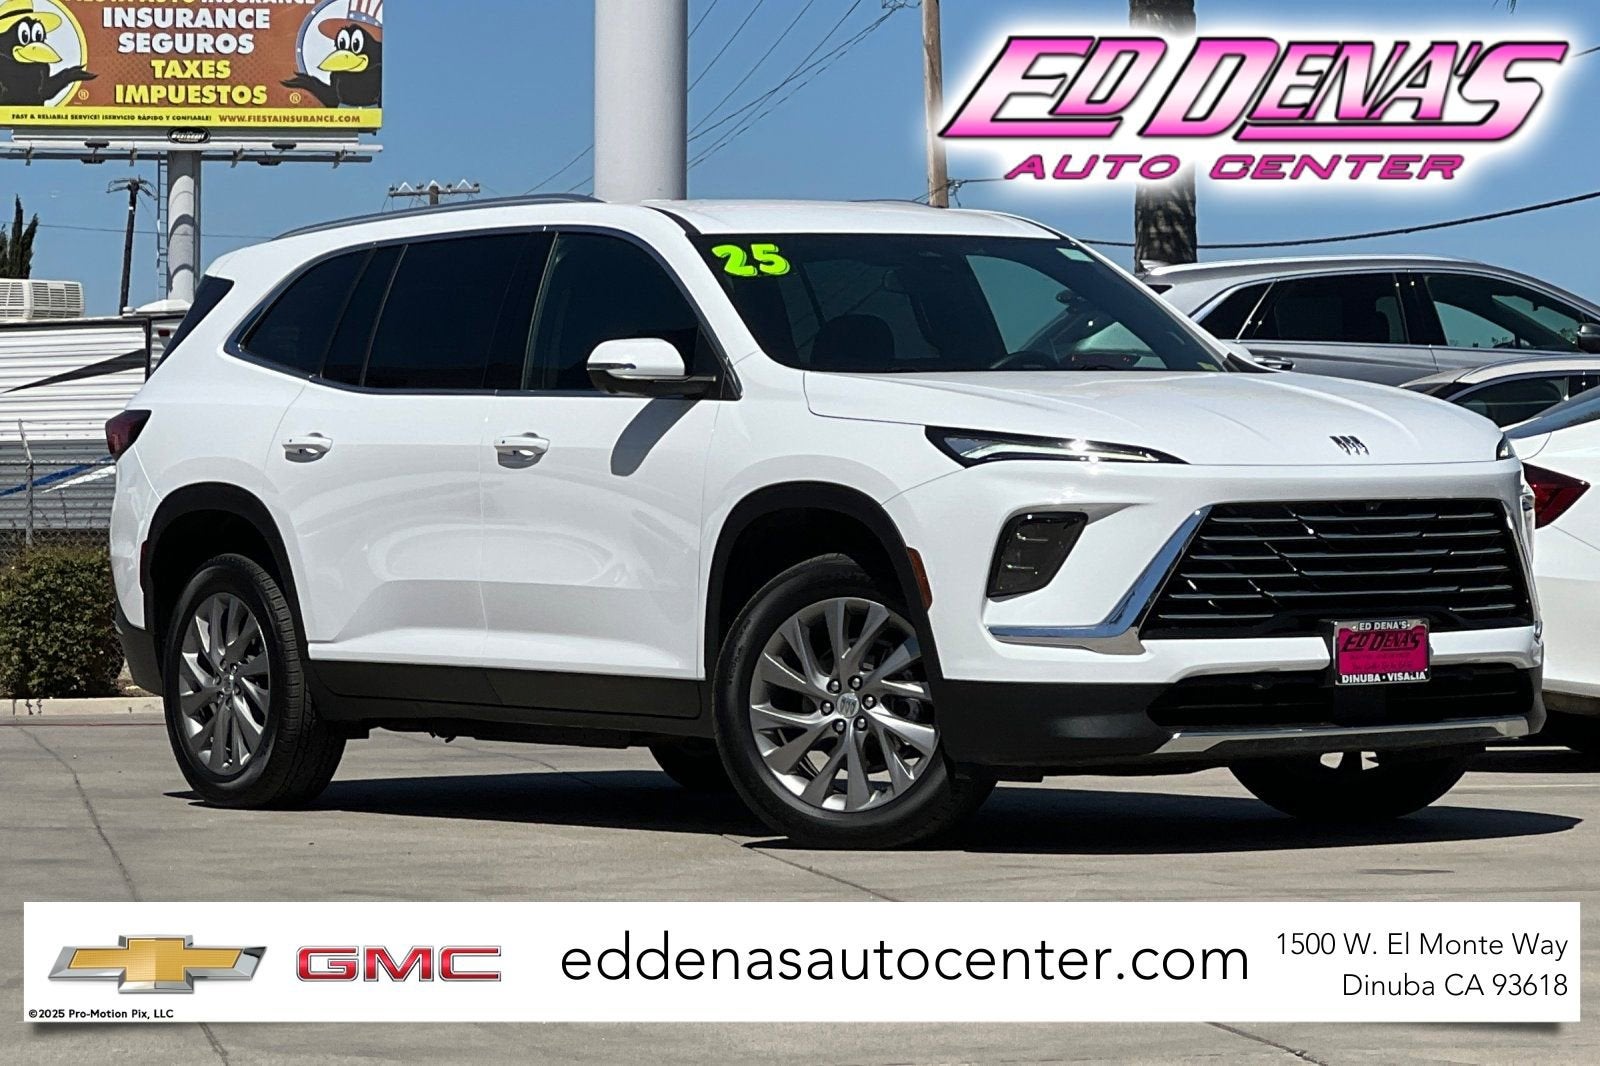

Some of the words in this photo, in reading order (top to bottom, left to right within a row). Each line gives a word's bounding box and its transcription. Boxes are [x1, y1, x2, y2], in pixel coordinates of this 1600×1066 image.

[103, 7, 270, 29] INSURANCE
[118, 32, 255, 54] SEGUROS
[151, 60, 231, 79] TAXES
[115, 84, 268, 105] IMPUESTOS
[218, 114, 361, 123] WWW.FIESTAINSURANCE.COM
[711, 243, 791, 277] 25
[1359, 622, 1372, 630] ED
[1373, 621, 1407, 630] DENA'S
[1340, 633, 1370, 652] ED
[1341, 674, 1381, 684] DINUBA
[1387, 671, 1426, 682] VISALIA
